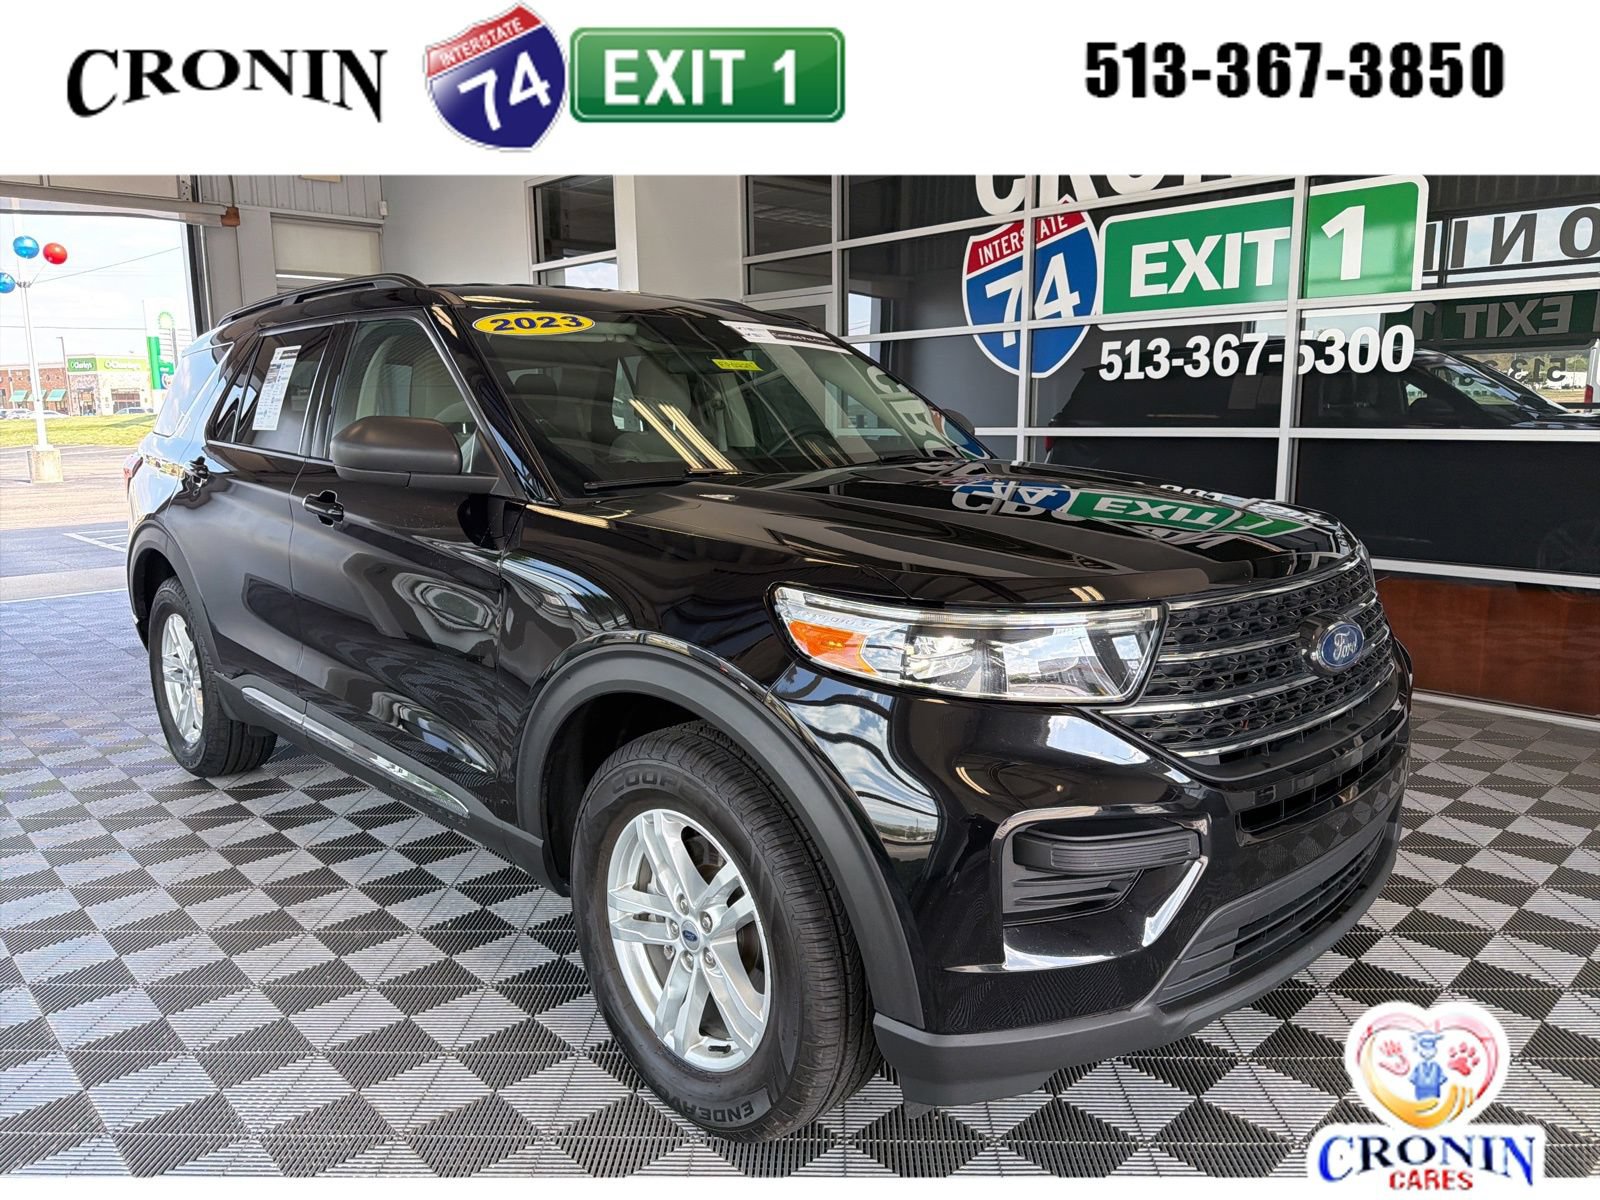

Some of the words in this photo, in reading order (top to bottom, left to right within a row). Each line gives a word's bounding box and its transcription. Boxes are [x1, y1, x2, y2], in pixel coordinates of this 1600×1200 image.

[977, 214, 1069, 266] INTERATE
[1130, 226, 1291, 298] EXIT
[1321, 205, 1365, 280] 1
[489, 315, 584, 332] 2023
[984, 252, 1081, 348] 74
[1098, 324, 1415, 381] 513-367-5300
[1332, 626, 1358, 661] Ford
